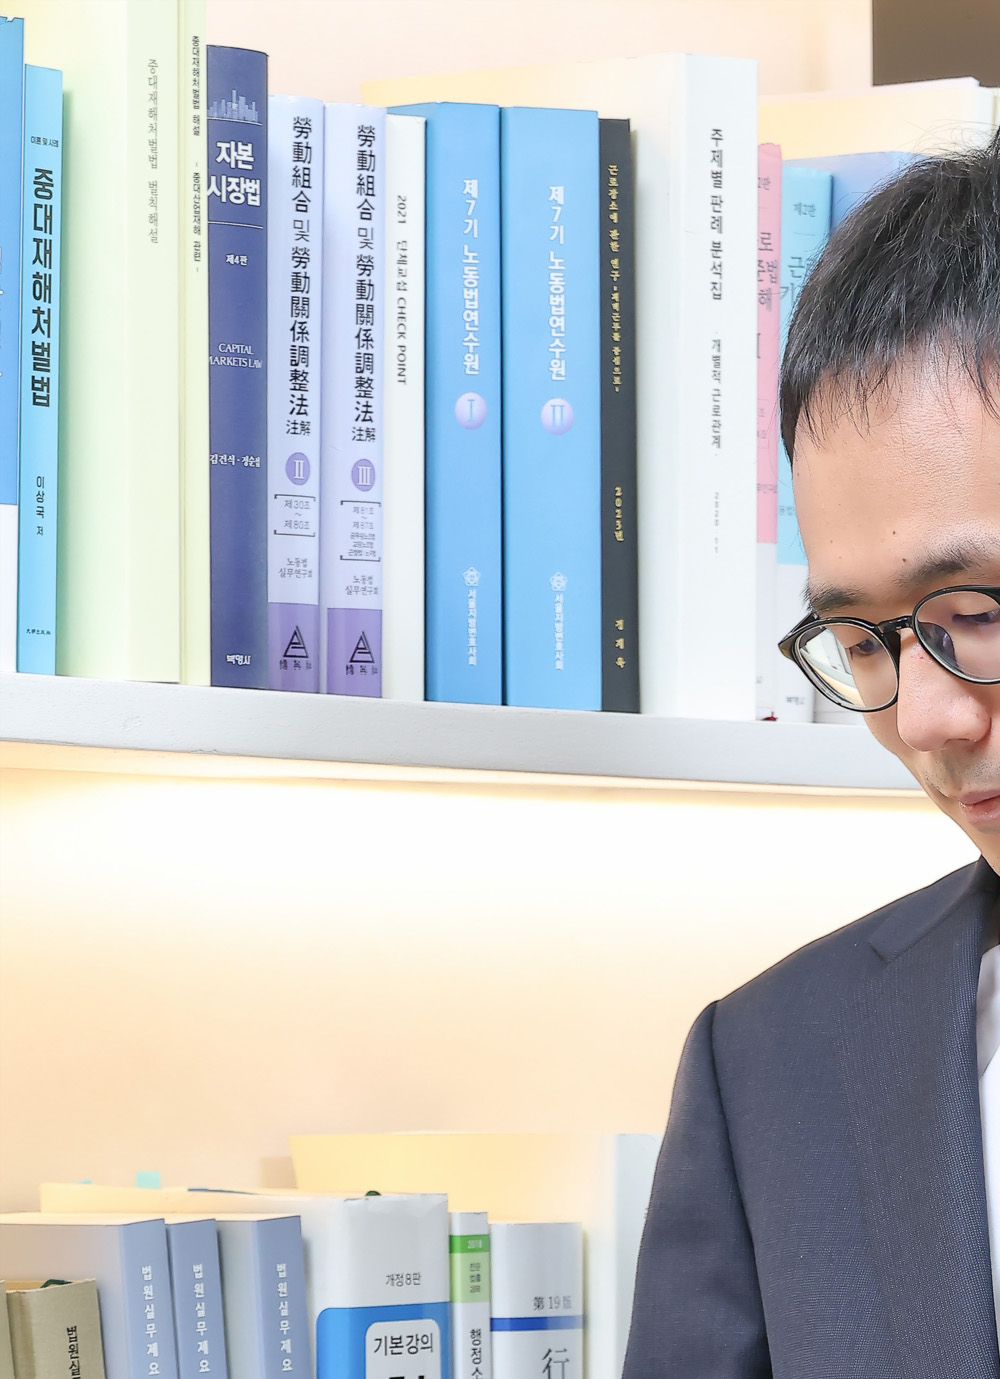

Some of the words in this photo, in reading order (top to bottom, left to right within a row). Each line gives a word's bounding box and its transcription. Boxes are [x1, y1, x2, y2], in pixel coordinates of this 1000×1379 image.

[192, 35, 201, 110] 중대재해처벌법
[147, 58, 160, 170] 중대재해처벌법
[215, 140, 255, 170] 자본
[291, 116, 313, 214] 勞動組合
[355, 125, 378, 221] 勞動組合
[147, 180, 159, 244] 벌칙해설
[207, 175, 262, 207] 시장법
[396, 194, 407, 225] 2021
[462, 178, 480, 239] 제7기
[547, 185, 565, 246] 제7기
[293, 219, 311, 242] 및
[357, 226, 376, 249] 및
[225, 253, 249, 267] 제4판
[396, 240, 408, 293] 단체교섭
[609, 258, 622, 283] 연구
[32, 167, 55, 408] 중대재해처벌법
[461, 244, 480, 376] 노동법연수원
[288, 246, 312, 417] 勞動關係調整法
[352, 254, 377, 424] 勞動關係調整法
[396, 297, 408, 341] CHECK
[547, 251, 566, 381] 노동법연수원
[218, 343, 254, 356] CAPITAL
[397, 344, 408, 385] POINT
[36, 475, 45, 519] 이상국
[283, 499, 310, 511] 제30조
[613, 486, 625, 542] 2023년
[36, 525, 44, 535] 저
[385, 1271, 422, 1289] 개정8판
[192, 1262, 211, 1379] 법원실무제요
[276, 1262, 294, 1379] 법원실무제요
[373, 1331, 435, 1358] 기본강의
